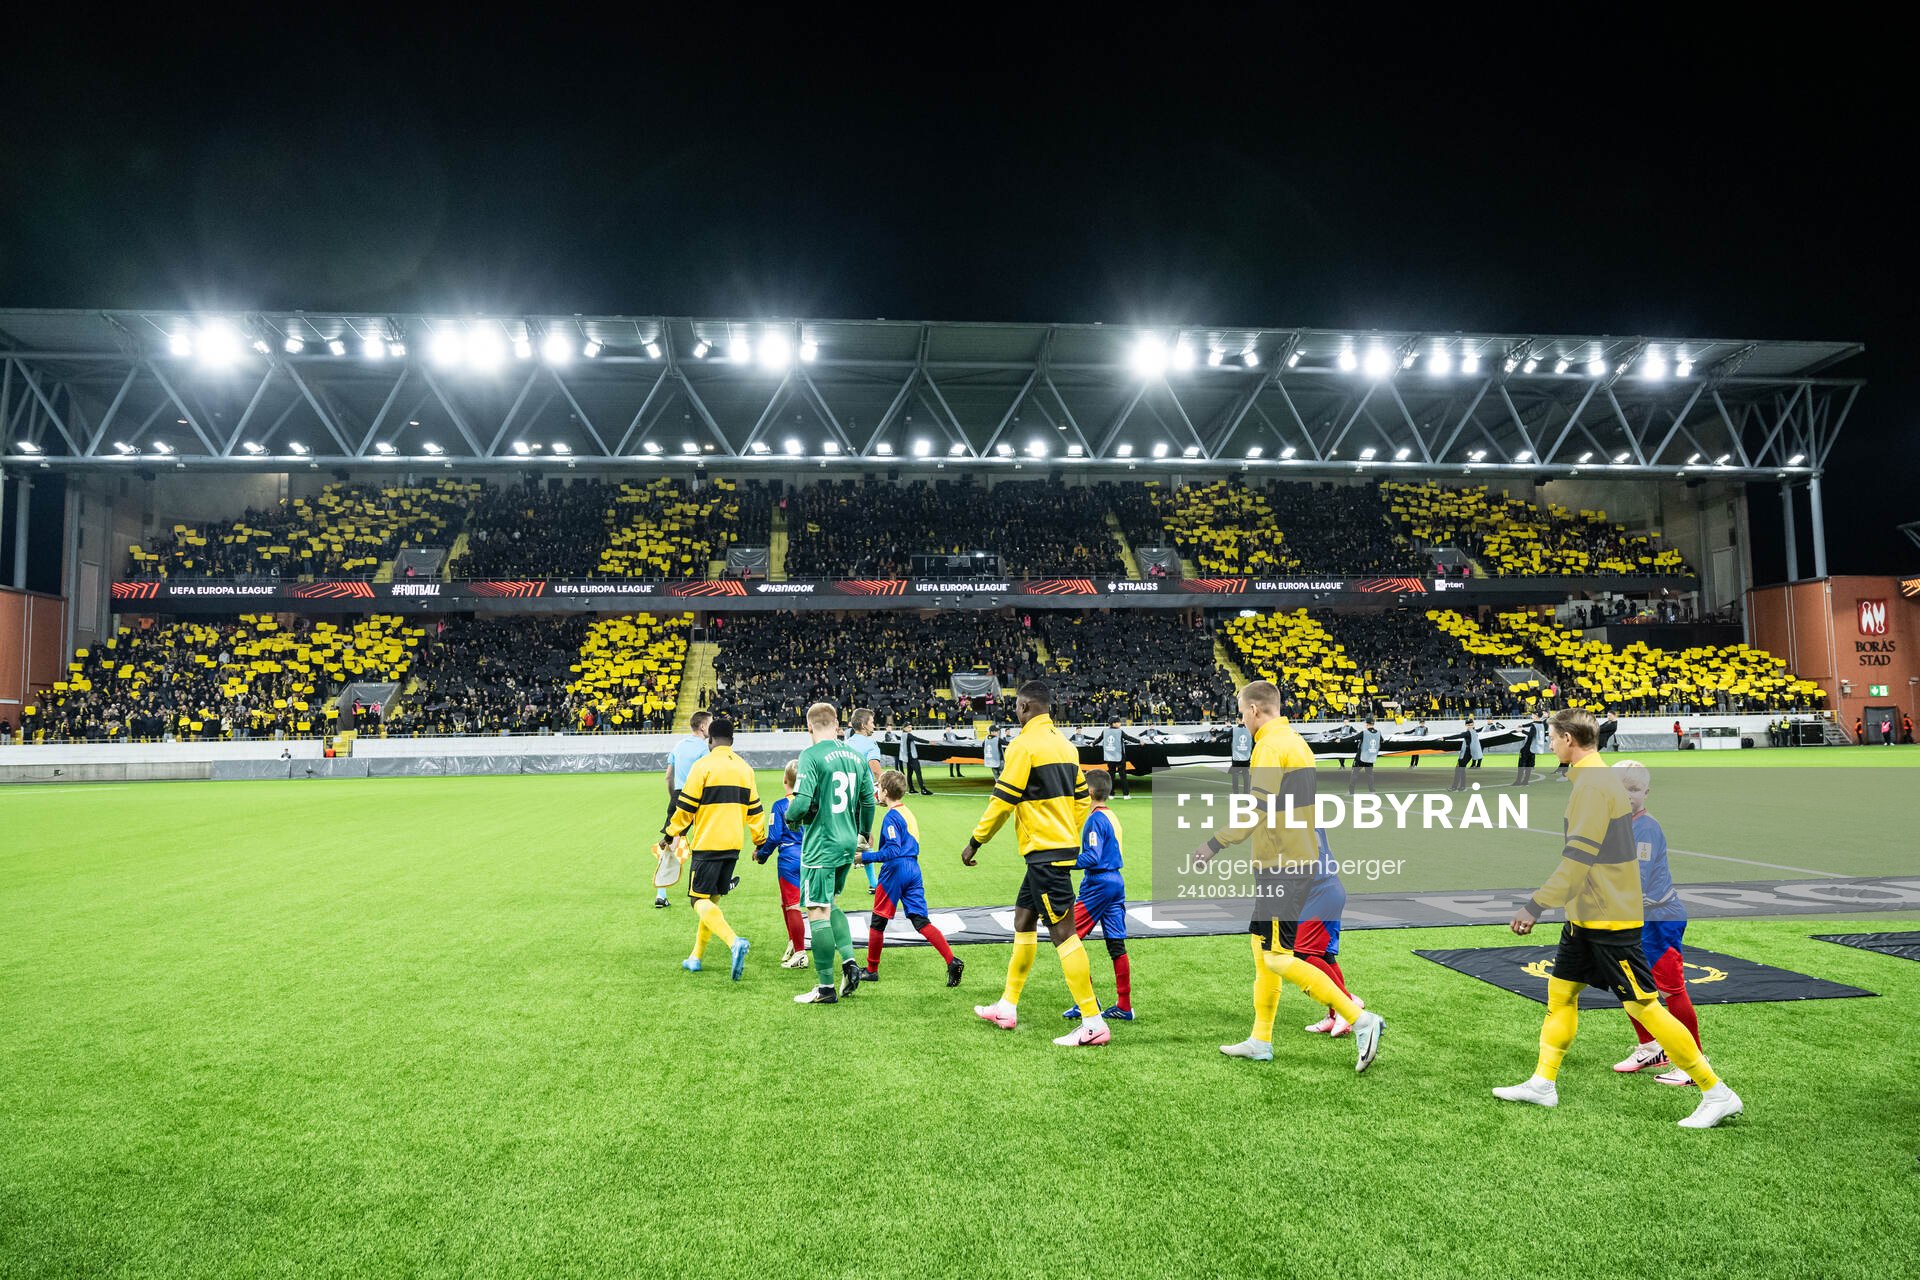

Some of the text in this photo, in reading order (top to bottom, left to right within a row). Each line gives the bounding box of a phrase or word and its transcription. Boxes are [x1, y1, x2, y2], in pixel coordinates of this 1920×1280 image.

[169, 586, 196, 595] UEFA
[197, 586, 235, 595] EUROPA
[391, 584, 441, 596] #FOOTBALL
[554, 585, 579, 593] UEFA
[580, 585, 616, 593] EUROPA
[915, 583, 939, 592] UEFA
[940, 583, 974, 592] EUROPA
[1117, 582, 1158, 591] STRAUSS
[1255, 582, 1277, 590] UEFA
[1278, 582, 1310, 590] EUROPA
[1855, 638, 1896, 652] BORÅS
[1859, 654, 1891, 666] STAD
[831, 771, 857, 814] 31
